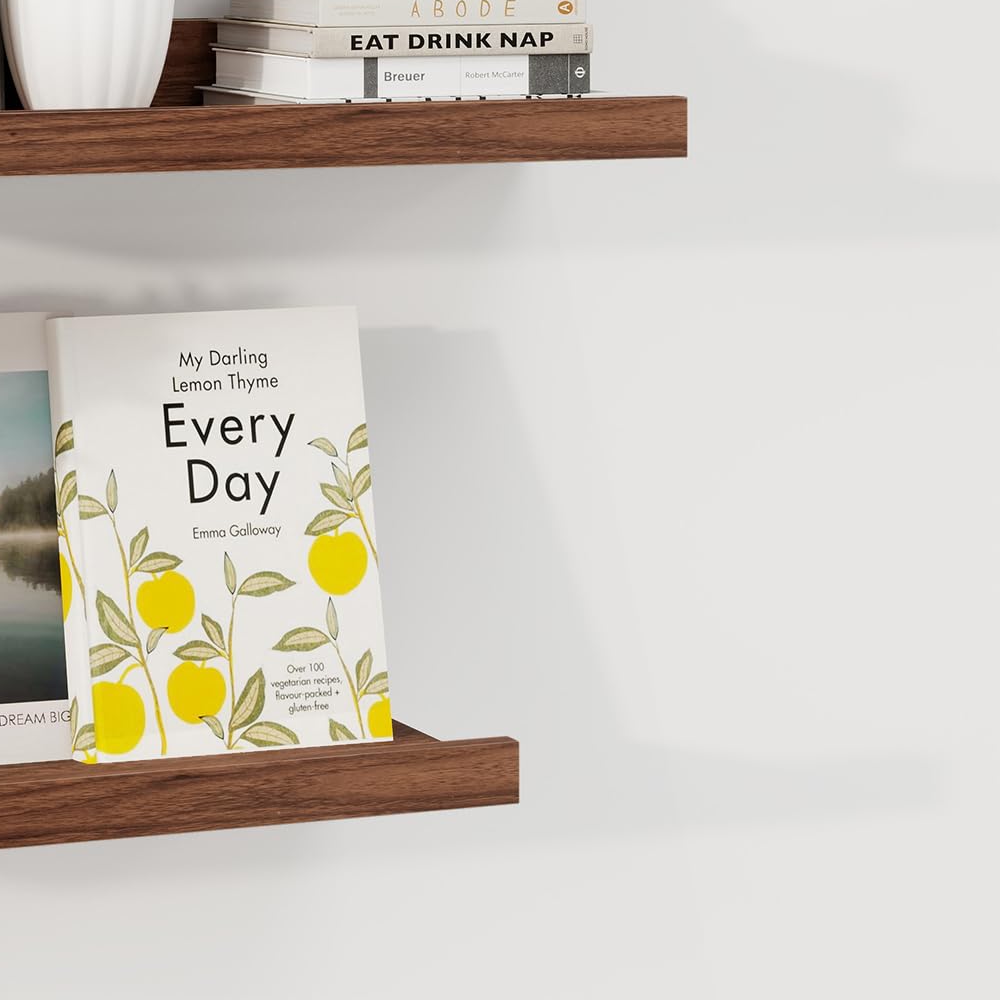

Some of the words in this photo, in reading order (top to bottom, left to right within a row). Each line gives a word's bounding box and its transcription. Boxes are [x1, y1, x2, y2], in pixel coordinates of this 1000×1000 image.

[411, 0, 517, 18] ABODE
[350, 34, 399, 50] EAT
[408, 32, 492, 49] DRINK
[500, 31, 554, 48] NAP
[384, 71, 426, 82] Breuer
[464, 71, 490, 79] Robert
[491, 70, 525, 79] McCarter
[179, 352, 203, 372] My
[209, 347, 268, 369] Darling
[172, 376, 222, 393] Lemon
[227, 371, 279, 394] Thyme
[162, 402, 296, 458] Every
[186, 458, 281, 516] Day
[192, 526, 227, 540] Emma
[229, 522, 282, 538] Galloway
[286, 664, 306, 674] Over
[309, 662, 325, 672] 100
[270, 677, 312, 690] vegetarian
[313, 675, 343, 686] recipes,
[275, 687, 333, 700] flavour-packed
[50, 710, 71, 723] BIG
[288, 700, 330, 716] gluten-free
